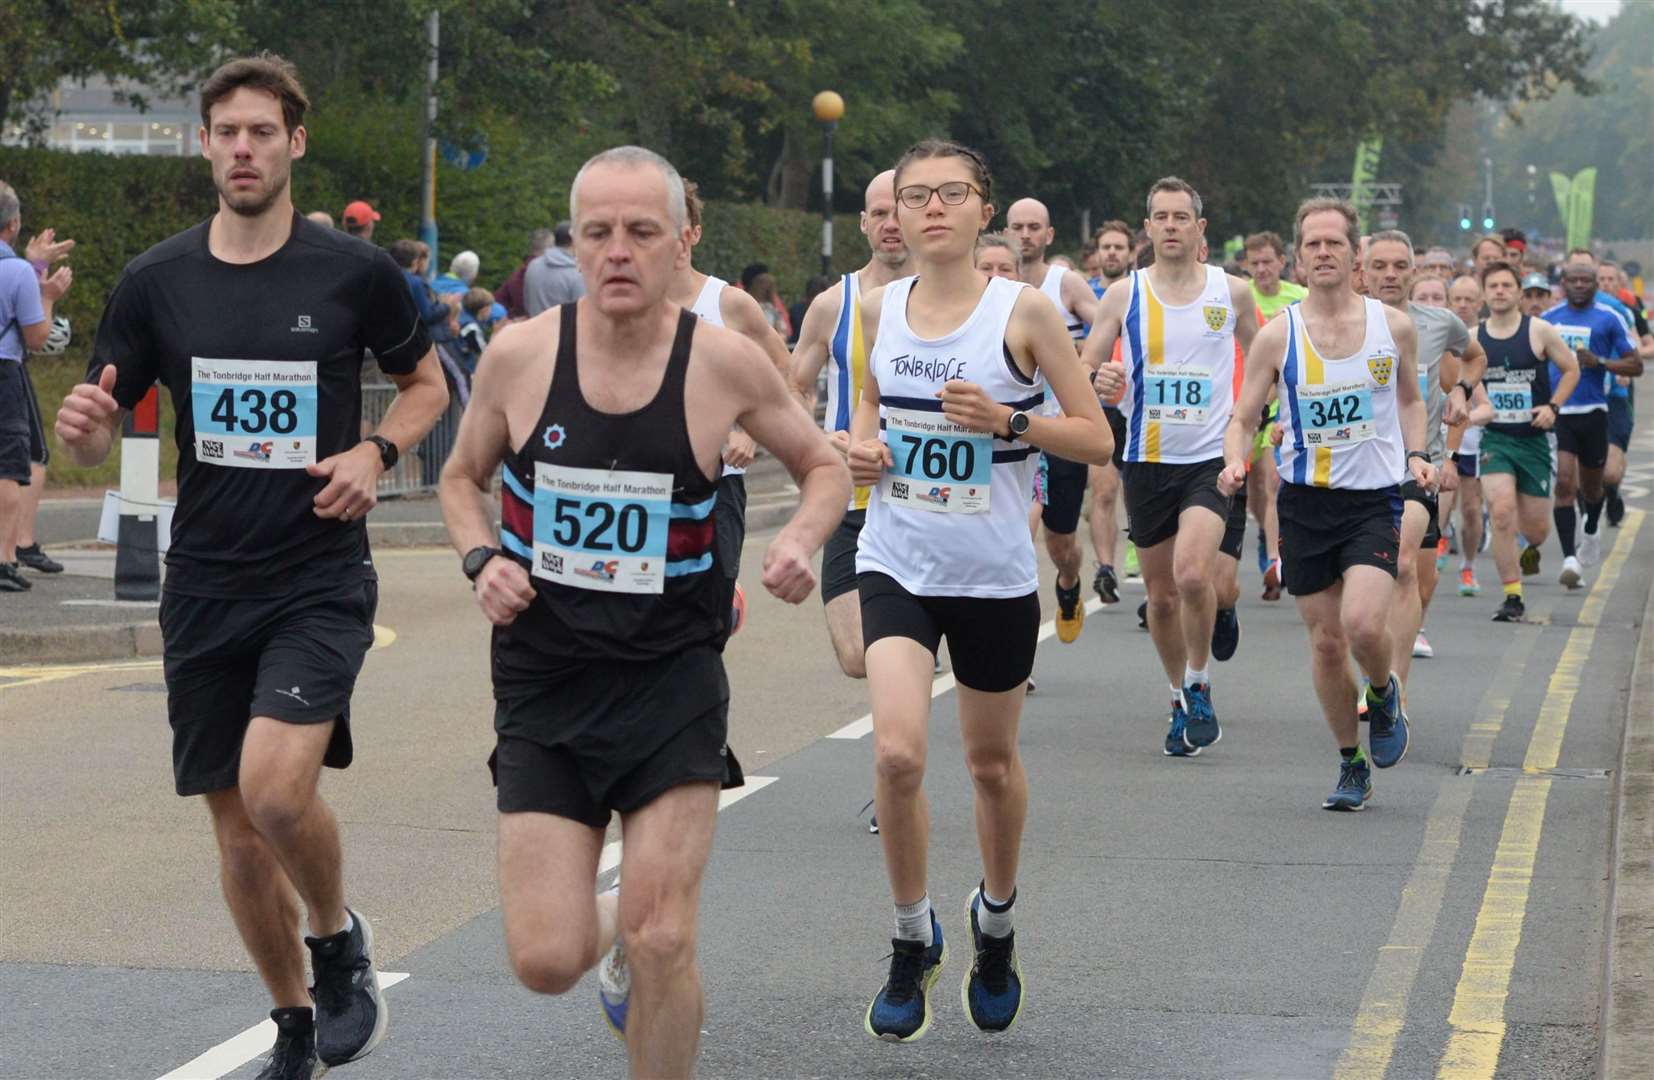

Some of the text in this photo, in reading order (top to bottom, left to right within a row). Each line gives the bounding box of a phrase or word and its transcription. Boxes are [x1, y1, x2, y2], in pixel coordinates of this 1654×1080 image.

[198, 370, 312, 382] The Tonbridge Half Marathon
[1155, 379, 1202, 405] 118
[1494, 393, 1524, 410] 356
[211, 388, 297, 434] 438
[1309, 395, 1363, 427] 342
[891, 417, 903, 426] The
[904, 418, 936, 432] Tonbridge
[937, 424, 952, 432] Half
[902, 435, 975, 482] 760
[542, 474, 666, 495] The Tonbridge Half Marathon
[553, 498, 648, 553] 520
